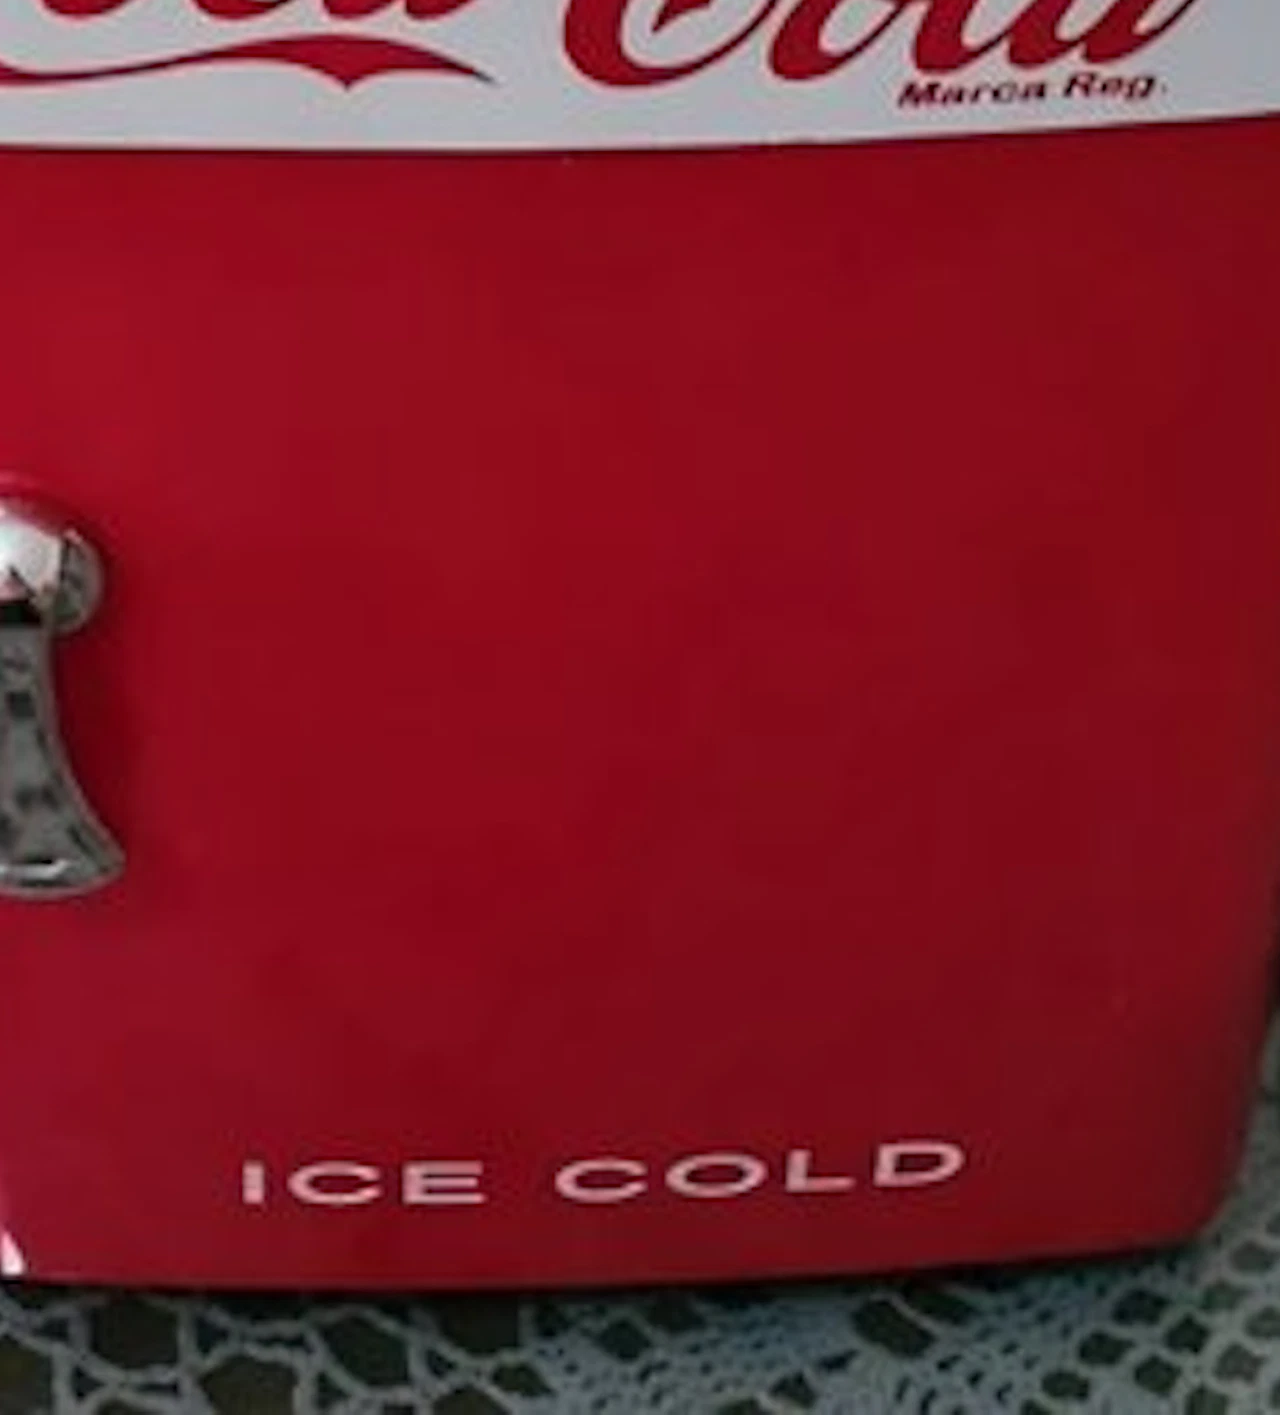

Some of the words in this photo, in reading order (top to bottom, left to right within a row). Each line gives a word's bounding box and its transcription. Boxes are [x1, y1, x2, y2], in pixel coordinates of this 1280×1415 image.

[897, 80, 1049, 110] Marca
[1062, 70, 1169, 100] Reg.
[241, 1161, 487, 1205] ICE
[554, 1140, 966, 1202] COLD
